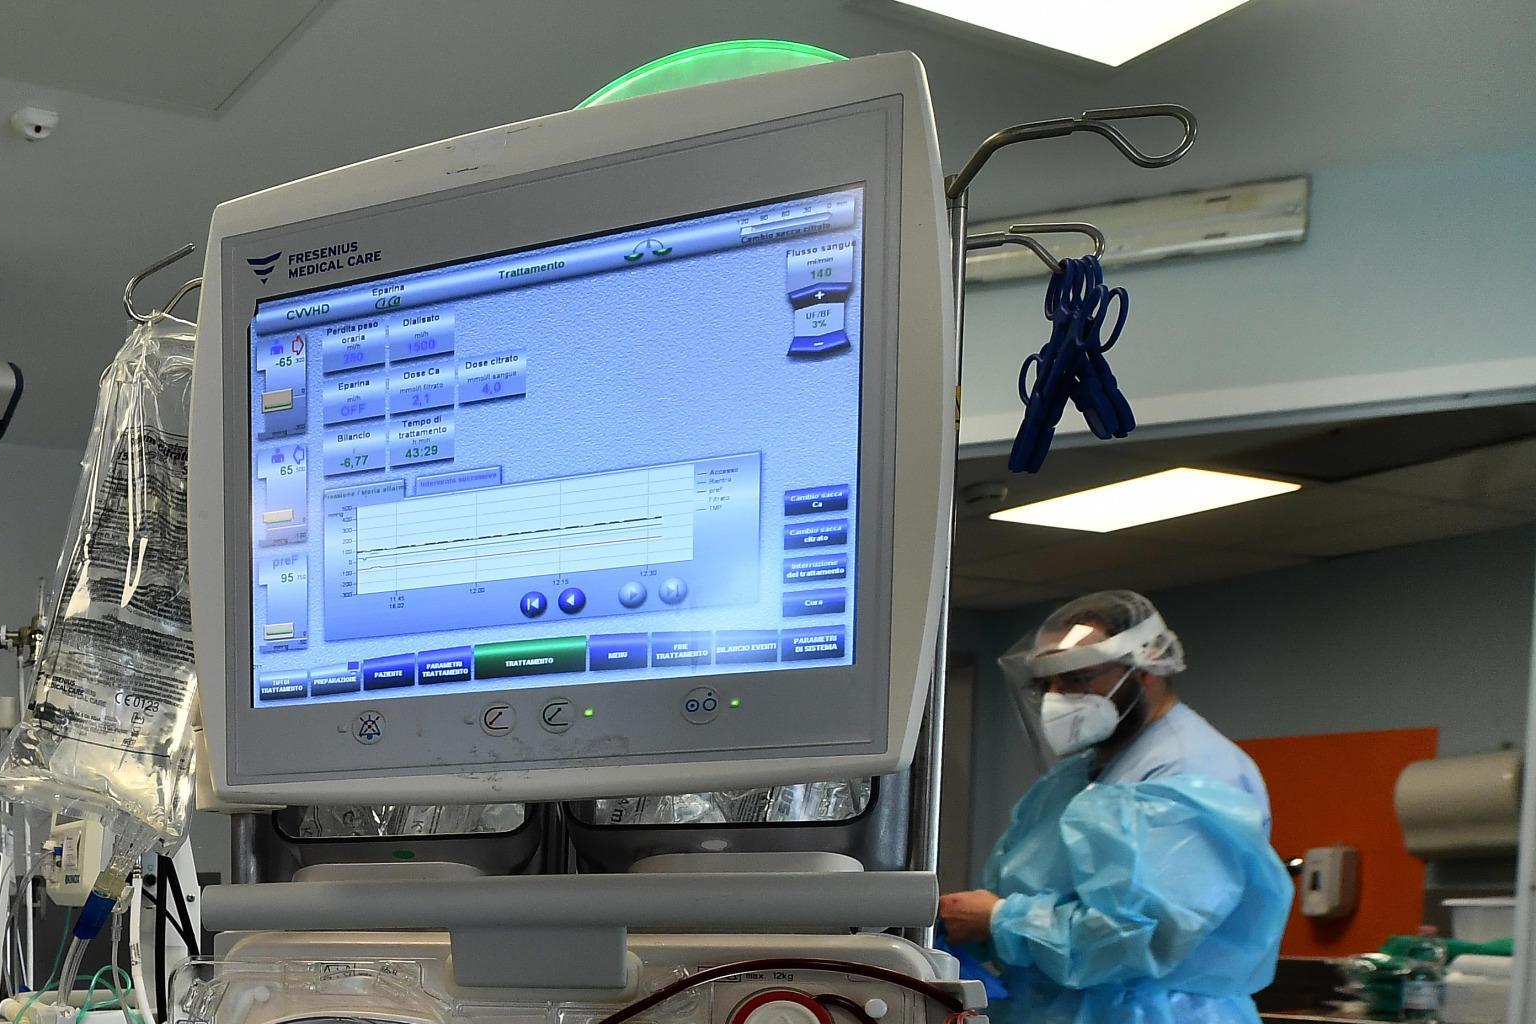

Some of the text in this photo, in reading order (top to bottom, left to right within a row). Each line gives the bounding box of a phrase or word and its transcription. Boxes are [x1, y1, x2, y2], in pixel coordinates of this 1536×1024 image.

[288, 241, 358, 266] FRESENIUS
[786, 240, 857, 258] Flusso sangue
[288, 250, 382, 279] MEDICAL CARE
[498, 260, 565, 280] Trattamento
[811, 267, 832, 279] 140
[372, 284, 405, 297] Eparina
[286, 303, 330, 321] CVVHD
[402, 314, 440, 327] Dialisato
[812, 320, 827, 329] 3%
[326, 320, 379, 336] Perdita peso
[341, 334, 366, 344] oraria
[275, 356, 293, 368] -65
[465, 355, 519, 370] Dose citrato
[403, 367, 440, 380] Dose Ca
[338, 380, 370, 392] Eparina
[341, 403, 366, 416] OFF
[402, 415, 442, 428] Tempo di
[337, 431, 371, 443] Bilancio
[398, 425, 447, 440] trattamento
[405, 445, 438, 459] 43:29
[339, 454, 369, 469] -6,77
[280, 465, 293, 476] 65
[803, 535, 829, 543] citrato
[272, 555, 299, 569] preF
[280, 573, 294, 583] 95
[799, 568, 845, 577] trattamento
[804, 599, 824, 607] Cura
[793, 635, 837, 645] PARAMETRI
[804, 643, 838, 652] SISTEMA
[656, 649, 709, 660] TRATTAMENTO
[505, 657, 554, 668] TRATTAMENTO
[374, 669, 403, 678] PAZIENTE
[421, 668, 469, 678] TRATTAMENTO
[261, 685, 304, 694] TRATTAMENTO
[133, 696, 161, 713] 0123
[773, 972, 794, 981] 12kg
